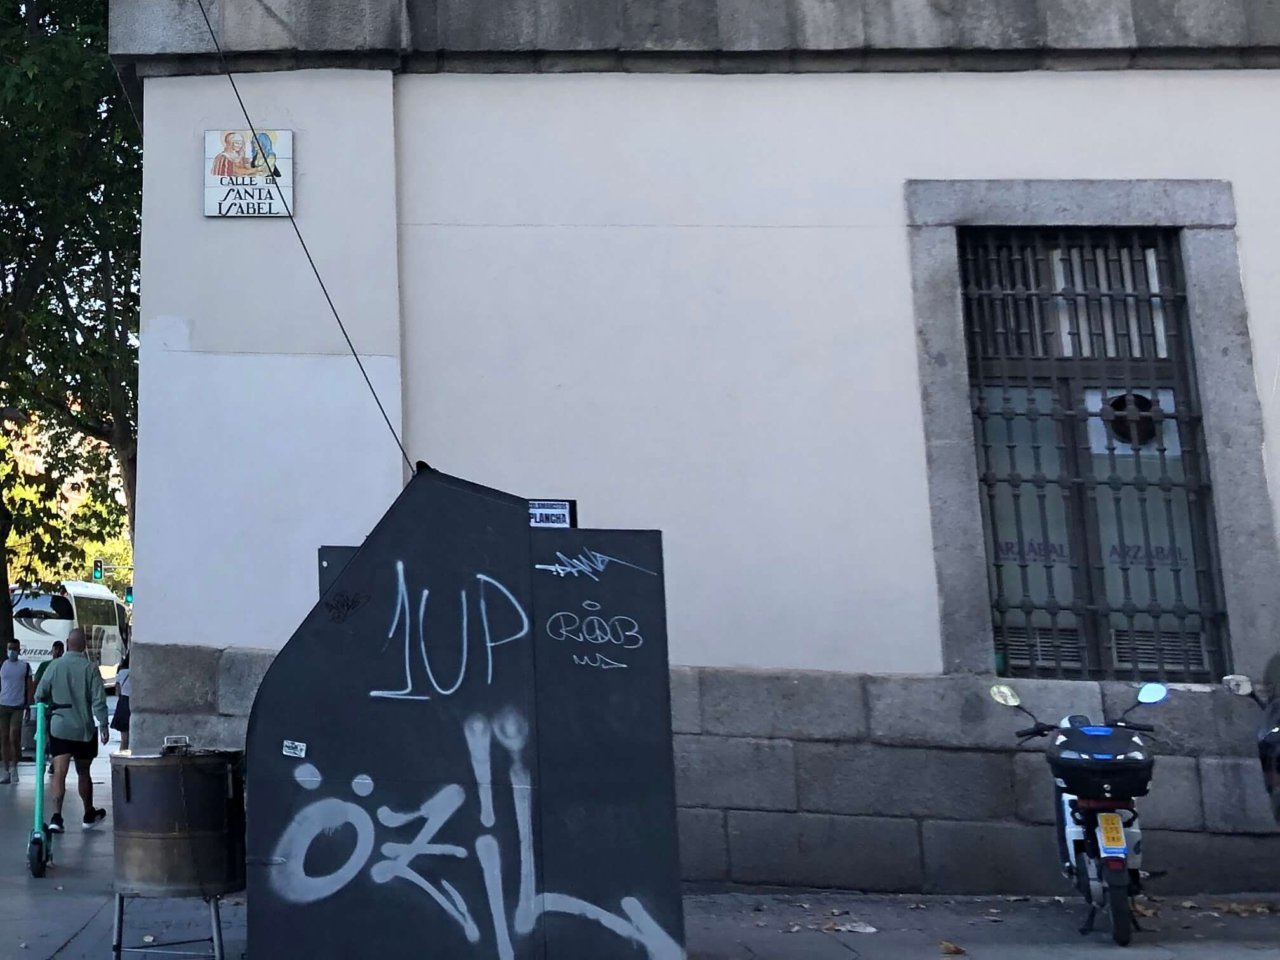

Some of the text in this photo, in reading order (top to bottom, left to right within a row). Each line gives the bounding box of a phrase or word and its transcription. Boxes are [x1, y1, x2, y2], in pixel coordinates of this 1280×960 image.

[220, 177, 258, 186] CALLE
[220, 188, 275, 202] SANTA
[217, 202, 280, 217] ISABEL
[369, 560, 530, 700] 1UP
